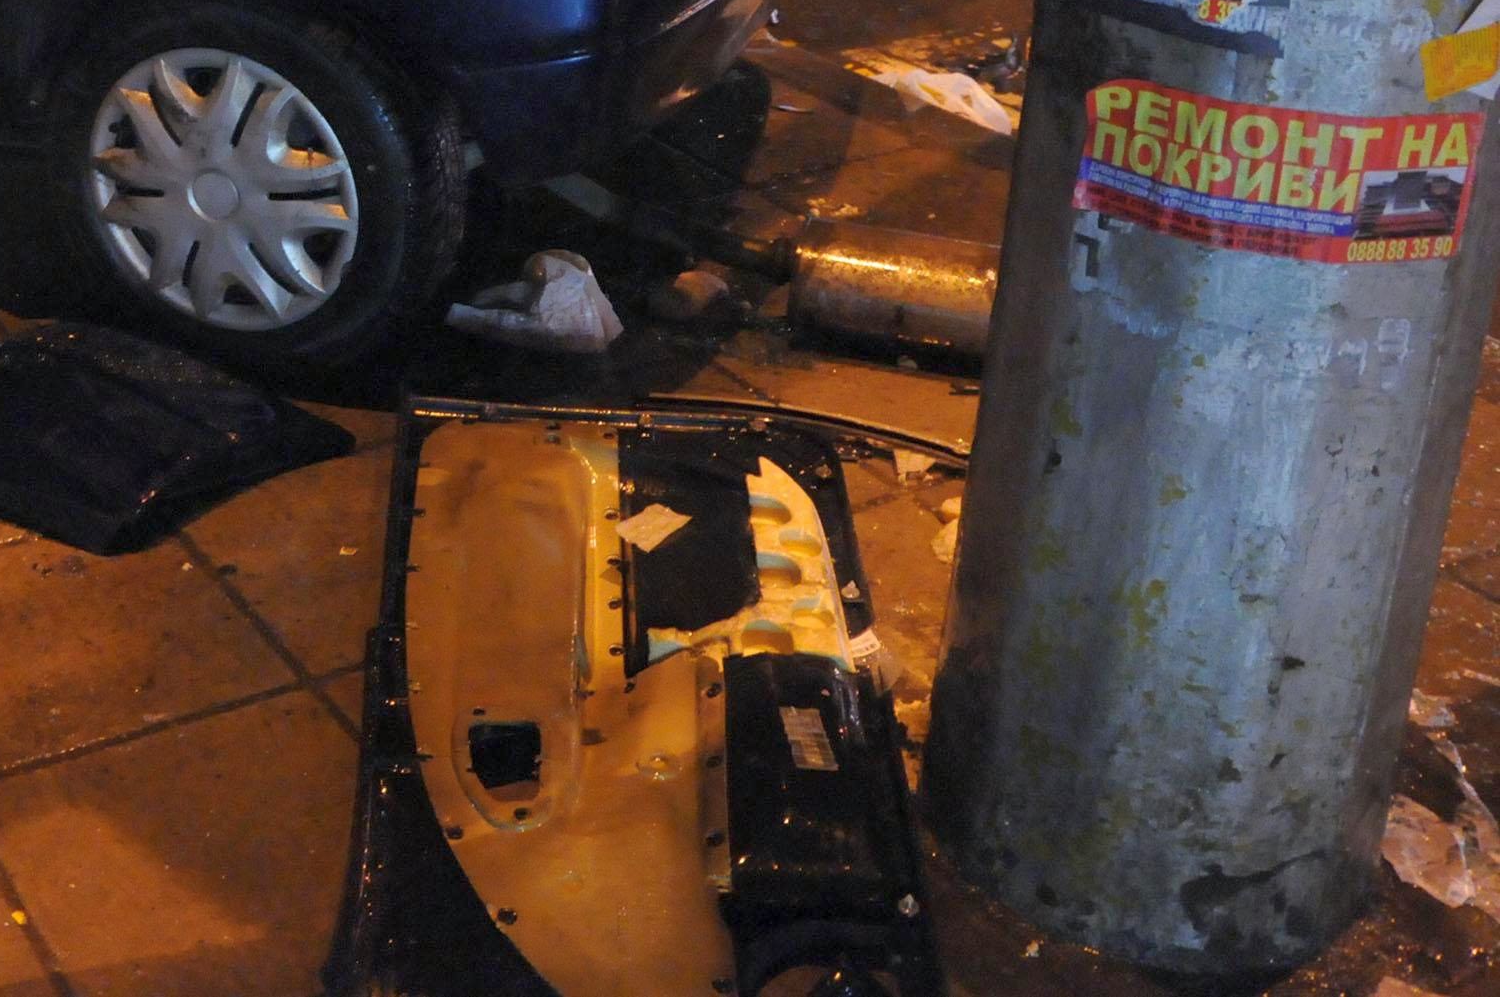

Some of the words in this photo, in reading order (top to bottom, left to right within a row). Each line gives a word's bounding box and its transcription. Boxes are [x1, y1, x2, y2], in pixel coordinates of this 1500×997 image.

[1092, 120, 1360, 214] ПОКРИВИ
[1095, 86, 1384, 171] РЕМОНТ
[1398, 122, 1470, 169] НА
